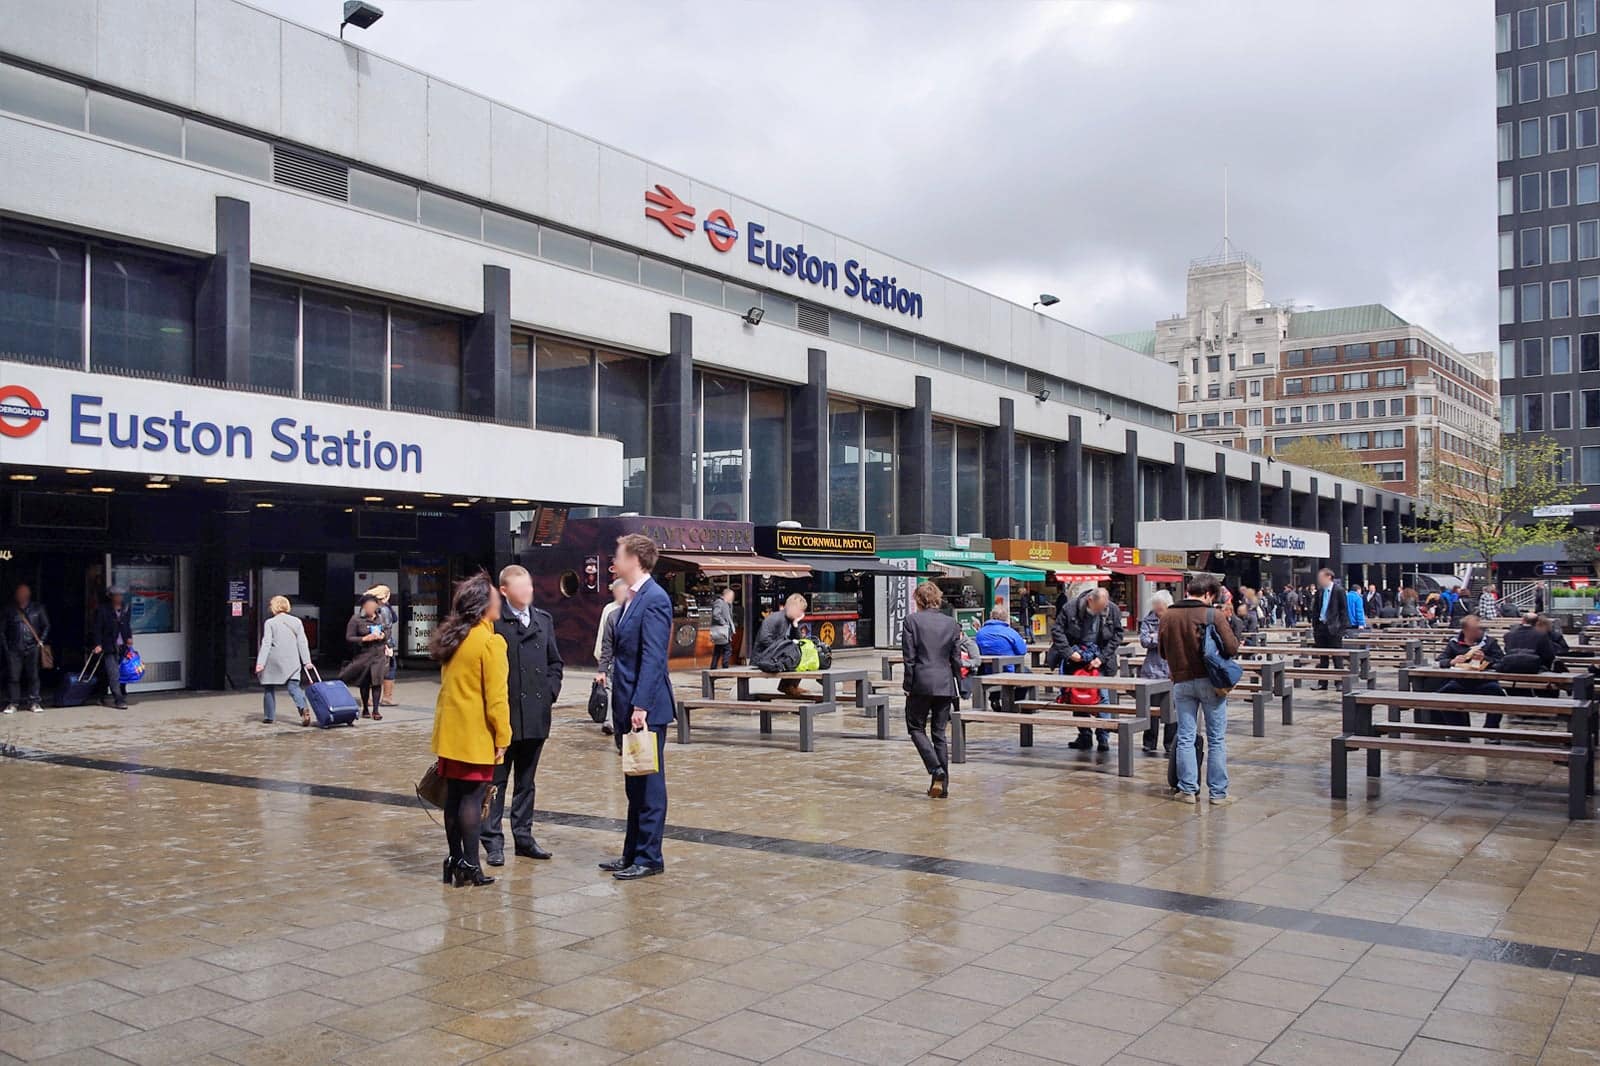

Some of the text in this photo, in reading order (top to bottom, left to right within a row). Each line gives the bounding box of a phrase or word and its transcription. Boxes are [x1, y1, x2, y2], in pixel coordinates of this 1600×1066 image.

[747, 221, 922, 319] Euston Station
[71, 394, 423, 474] Euston Station
[688, 527, 742, 545] COFFEE
[781, 535, 801, 547] WEST
[802, 536, 842, 548] CORNWALL
[843, 538, 863, 549] PASTY
[1271, 533, 1306, 550] Euston Station
